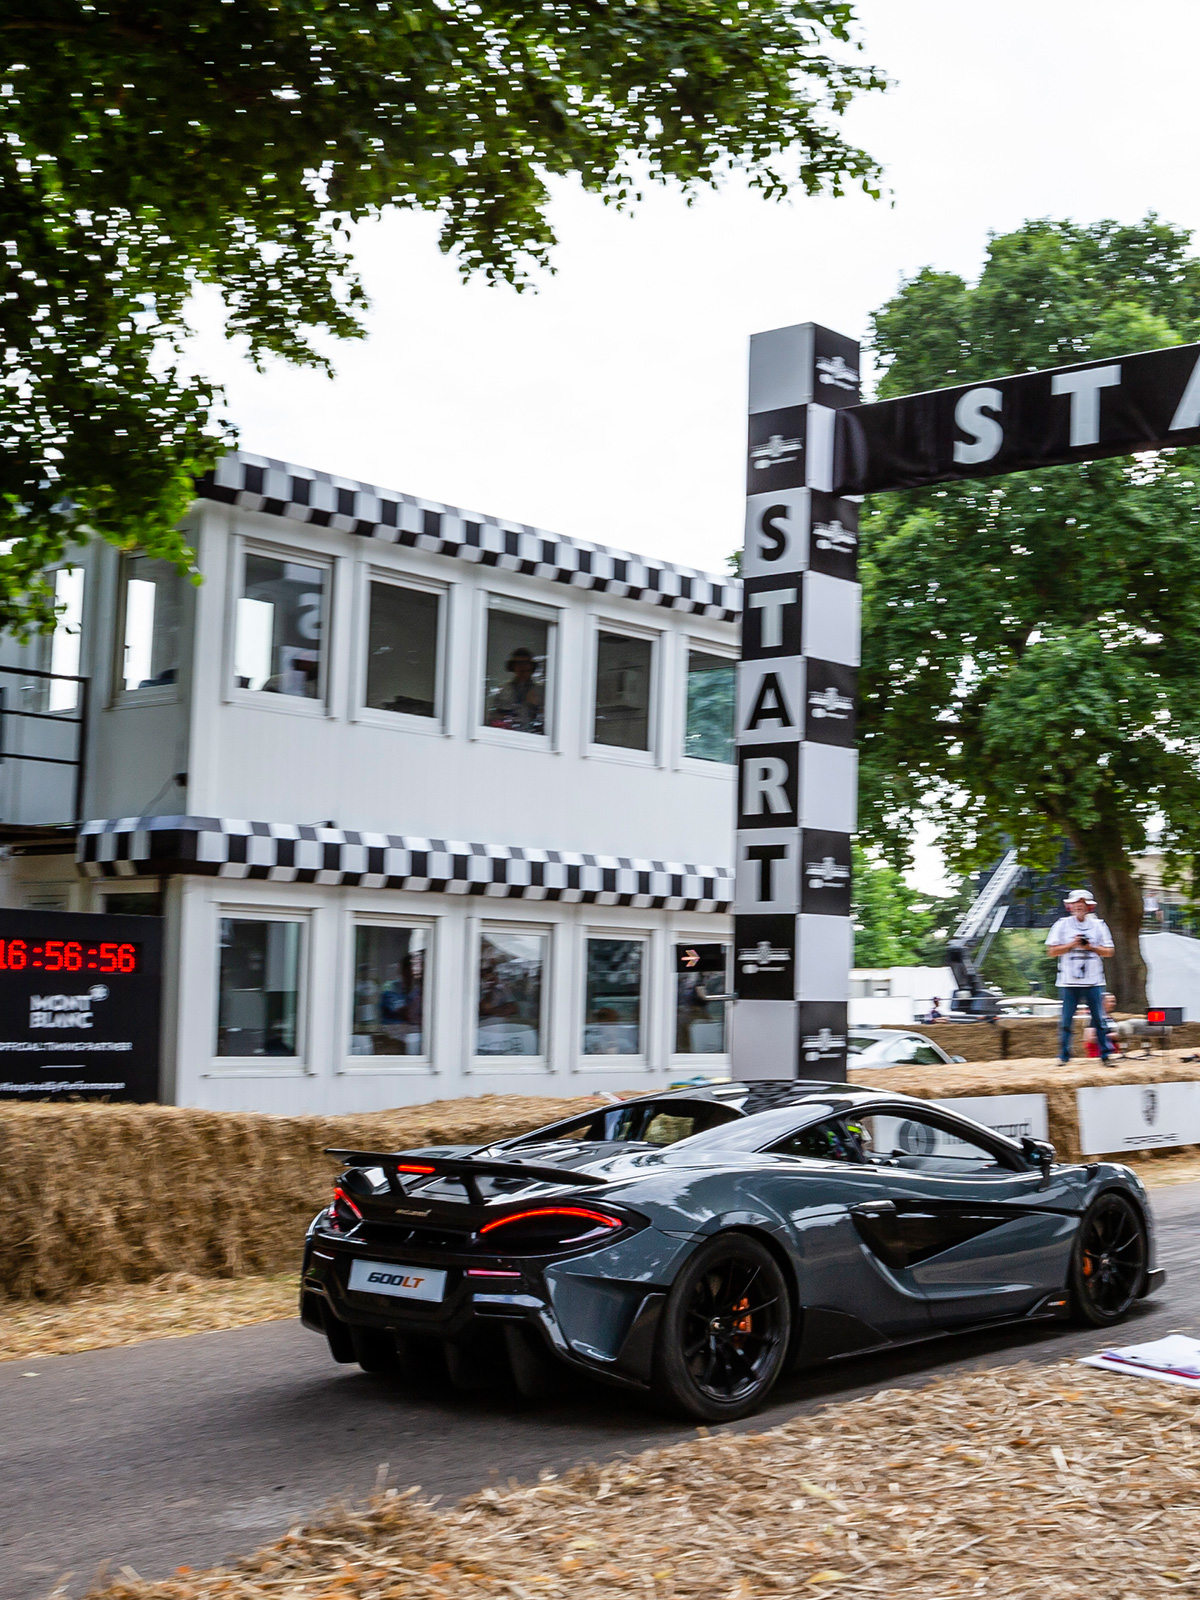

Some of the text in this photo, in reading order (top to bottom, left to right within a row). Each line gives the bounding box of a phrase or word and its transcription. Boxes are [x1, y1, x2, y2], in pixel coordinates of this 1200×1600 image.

[742, 503, 798, 902] START
[29, 1011, 94, 1029] BLANC
[367, 1271, 425, 1289] 600LT
